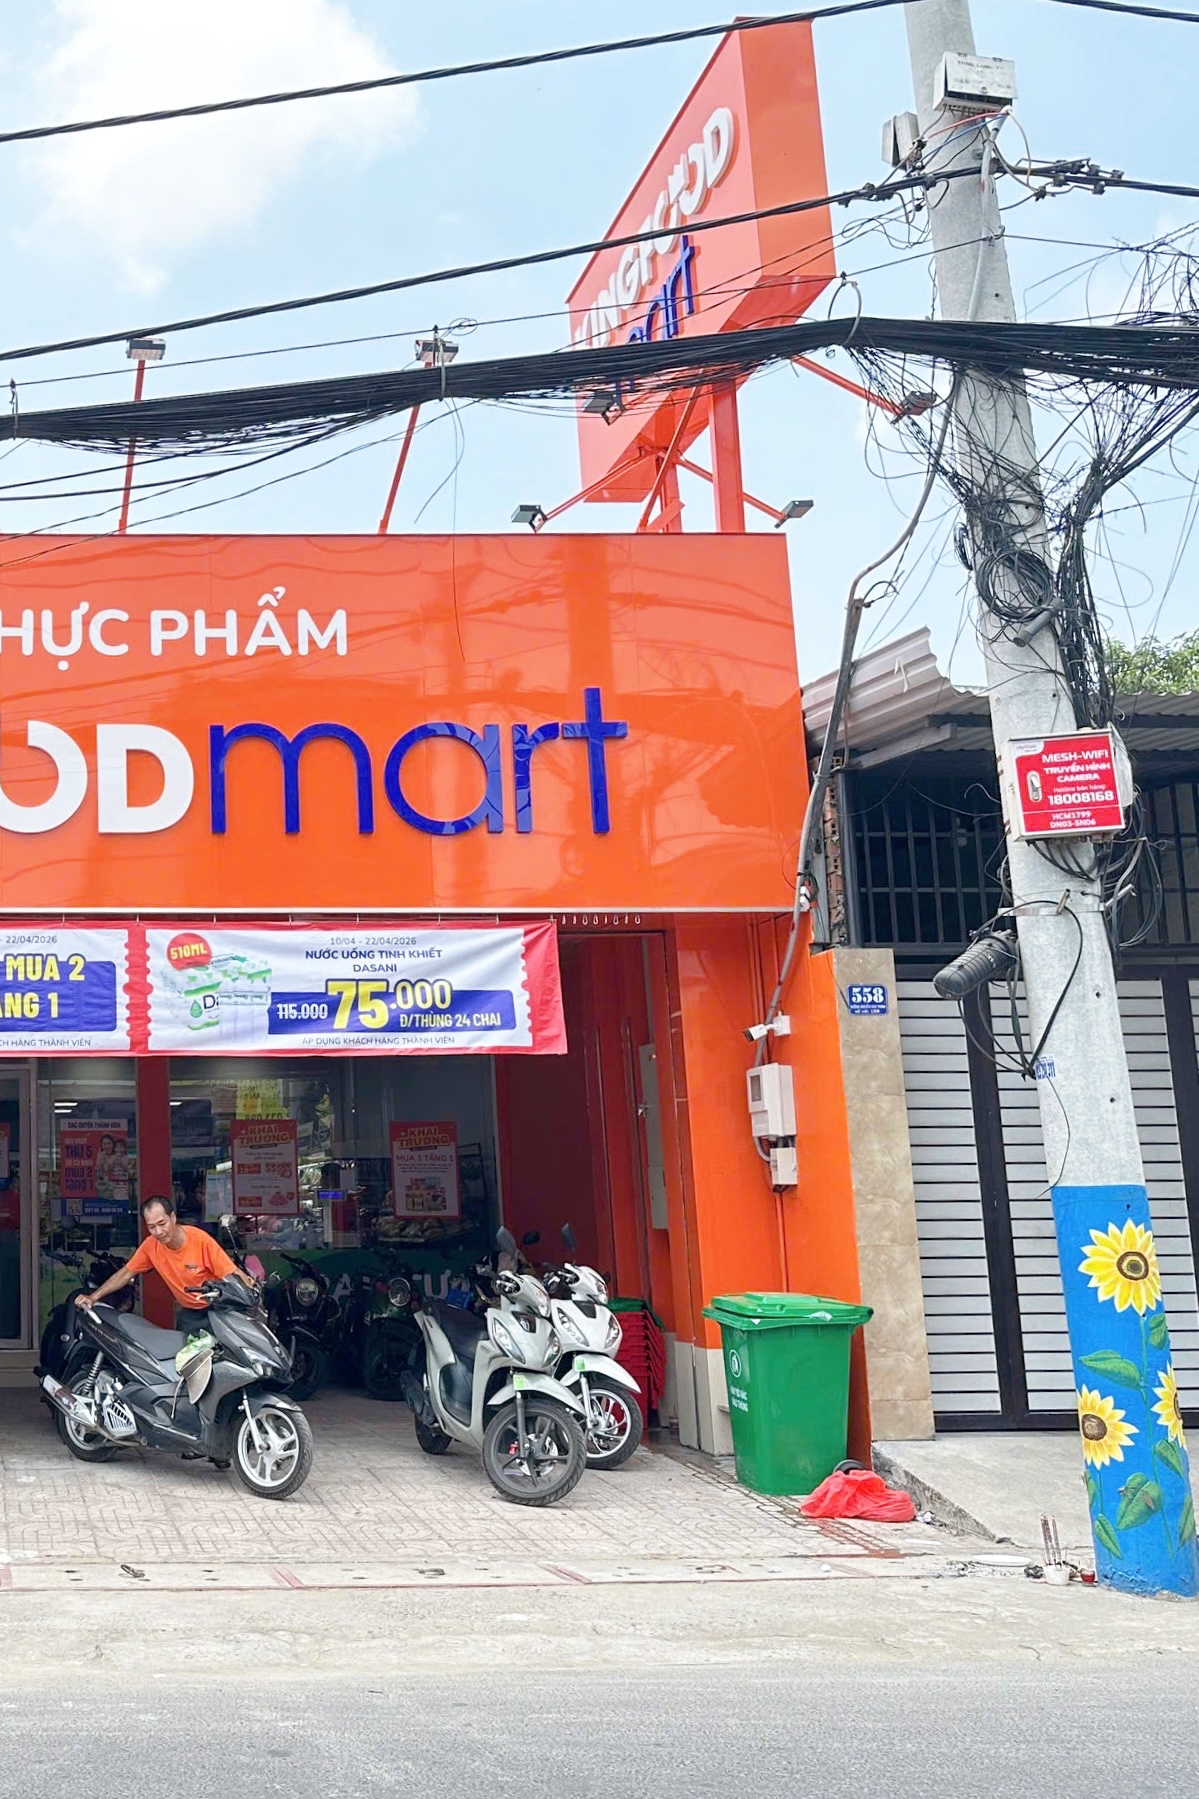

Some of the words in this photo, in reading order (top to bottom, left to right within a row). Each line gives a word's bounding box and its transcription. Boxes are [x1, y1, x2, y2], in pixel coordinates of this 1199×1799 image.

[150, 586, 348, 656] PHẨM
[1041, 750, 1109, 763] MESH-WIFI
[1086, 762, 1110, 771] HÌNH
[1056, 773, 1100, 782] CAMERA
[1047, 790, 1114, 806] 18008168
[1052, 811, 1091, 820] HCM1799
[6, 936, 58, 944] 22/04/2026
[330, 937, 356, 945] 10/04
[365, 937, 417, 945] 22/04/2026
[170, 943, 208, 960] 510ML
[305, 948, 338, 960] NƯỚC
[342, 947, 375, 959] UỐNG
[378, 950, 405, 959] TINH
[409, 948, 443, 958] KHIẾT
[5, 955, 61, 982] MUA
[68, 954, 86, 981] 2
[353, 964, 397, 973] DASANI
[851, 986, 884, 1003] 558
[47, 992, 59, 1018] 1
[277, 1003, 328, 1020] 115.000
[400, 1012, 452, 1028] Đ/THÙNG
[455, 1014, 471, 1027] 24
[473, 1013, 501, 1026] CHAI
[11, 1038, 36, 1046] HÀNG
[39, 1038, 69, 1046] THÀNH
[343, 1036, 373, 1045] KHÁCH
[375, 1036, 399, 1045] HÀNG
[402, 1036, 433, 1045] THÀNH
[250, 1125, 278, 1135] KHAI
[409, 1127, 437, 1137] KHAI
